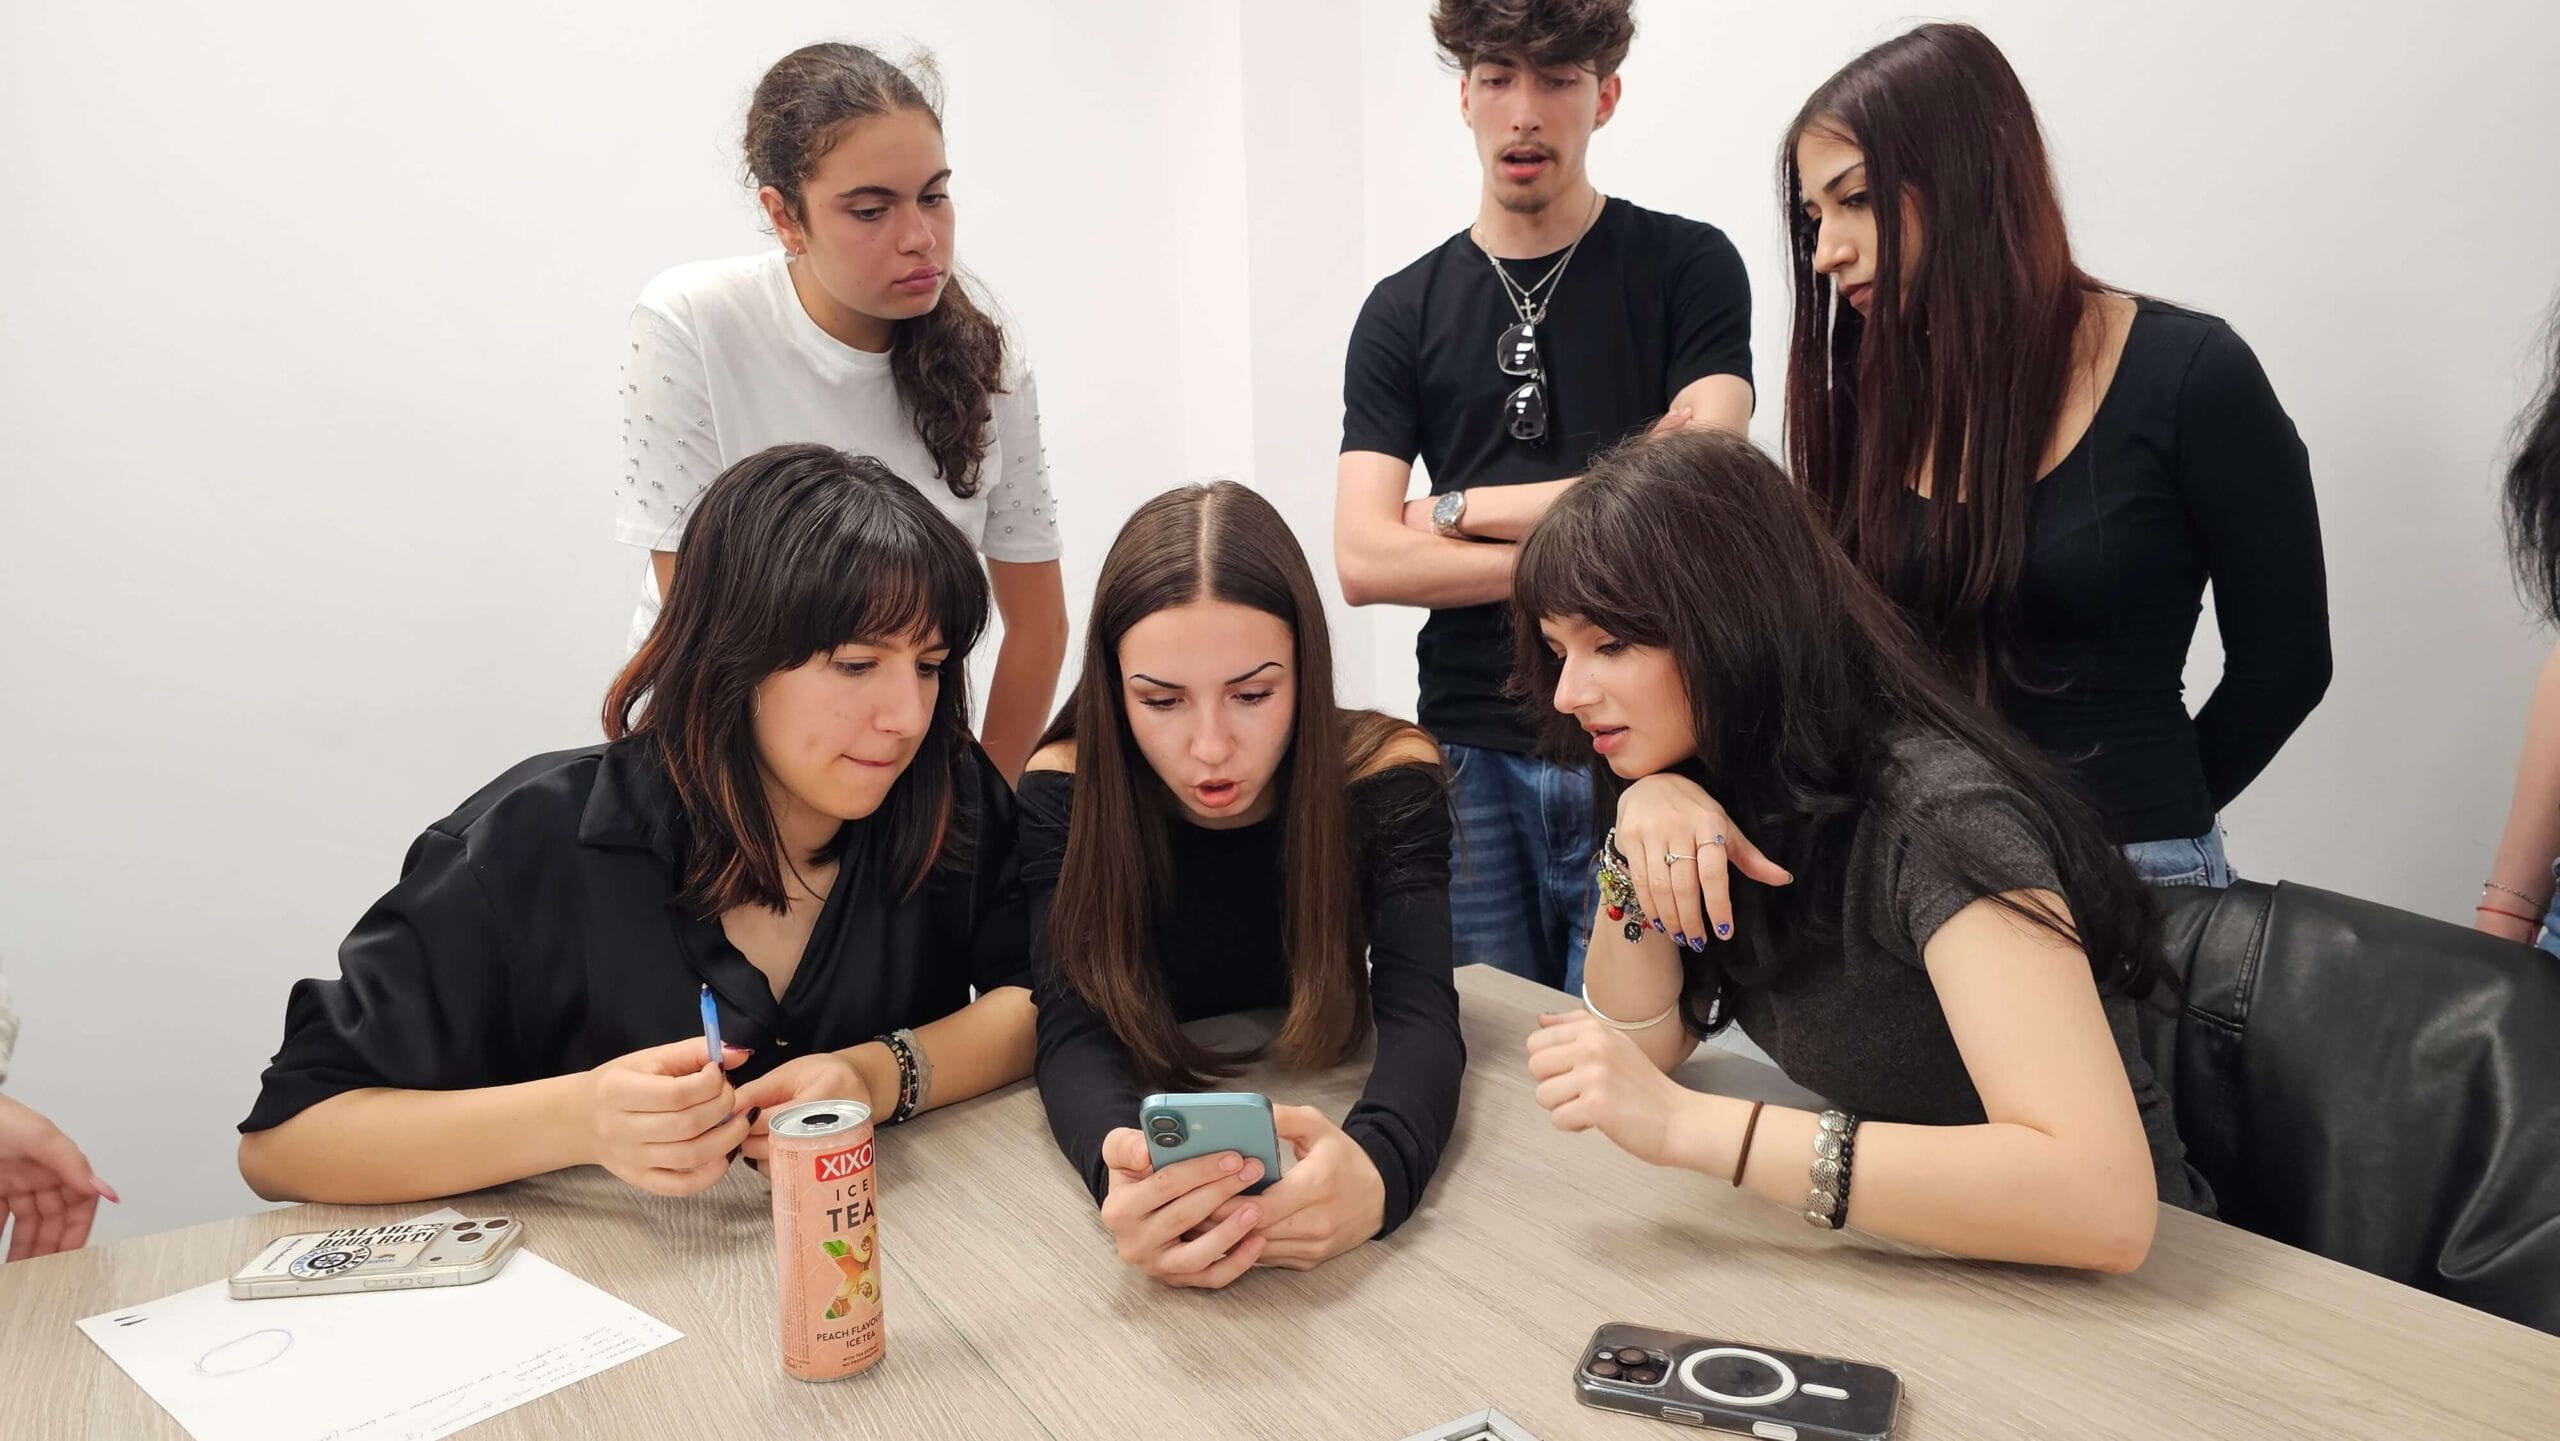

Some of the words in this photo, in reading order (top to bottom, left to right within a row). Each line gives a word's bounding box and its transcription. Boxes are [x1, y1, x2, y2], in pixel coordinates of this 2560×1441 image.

[821, 1143, 873, 1179] XIXO
[836, 1178, 868, 1201] ICE
[826, 1197, 875, 1232] TEA
[816, 1329, 849, 1341] PEACH
[846, 1336, 863, 1349] ICE
[863, 1330, 876, 1343] TEA
